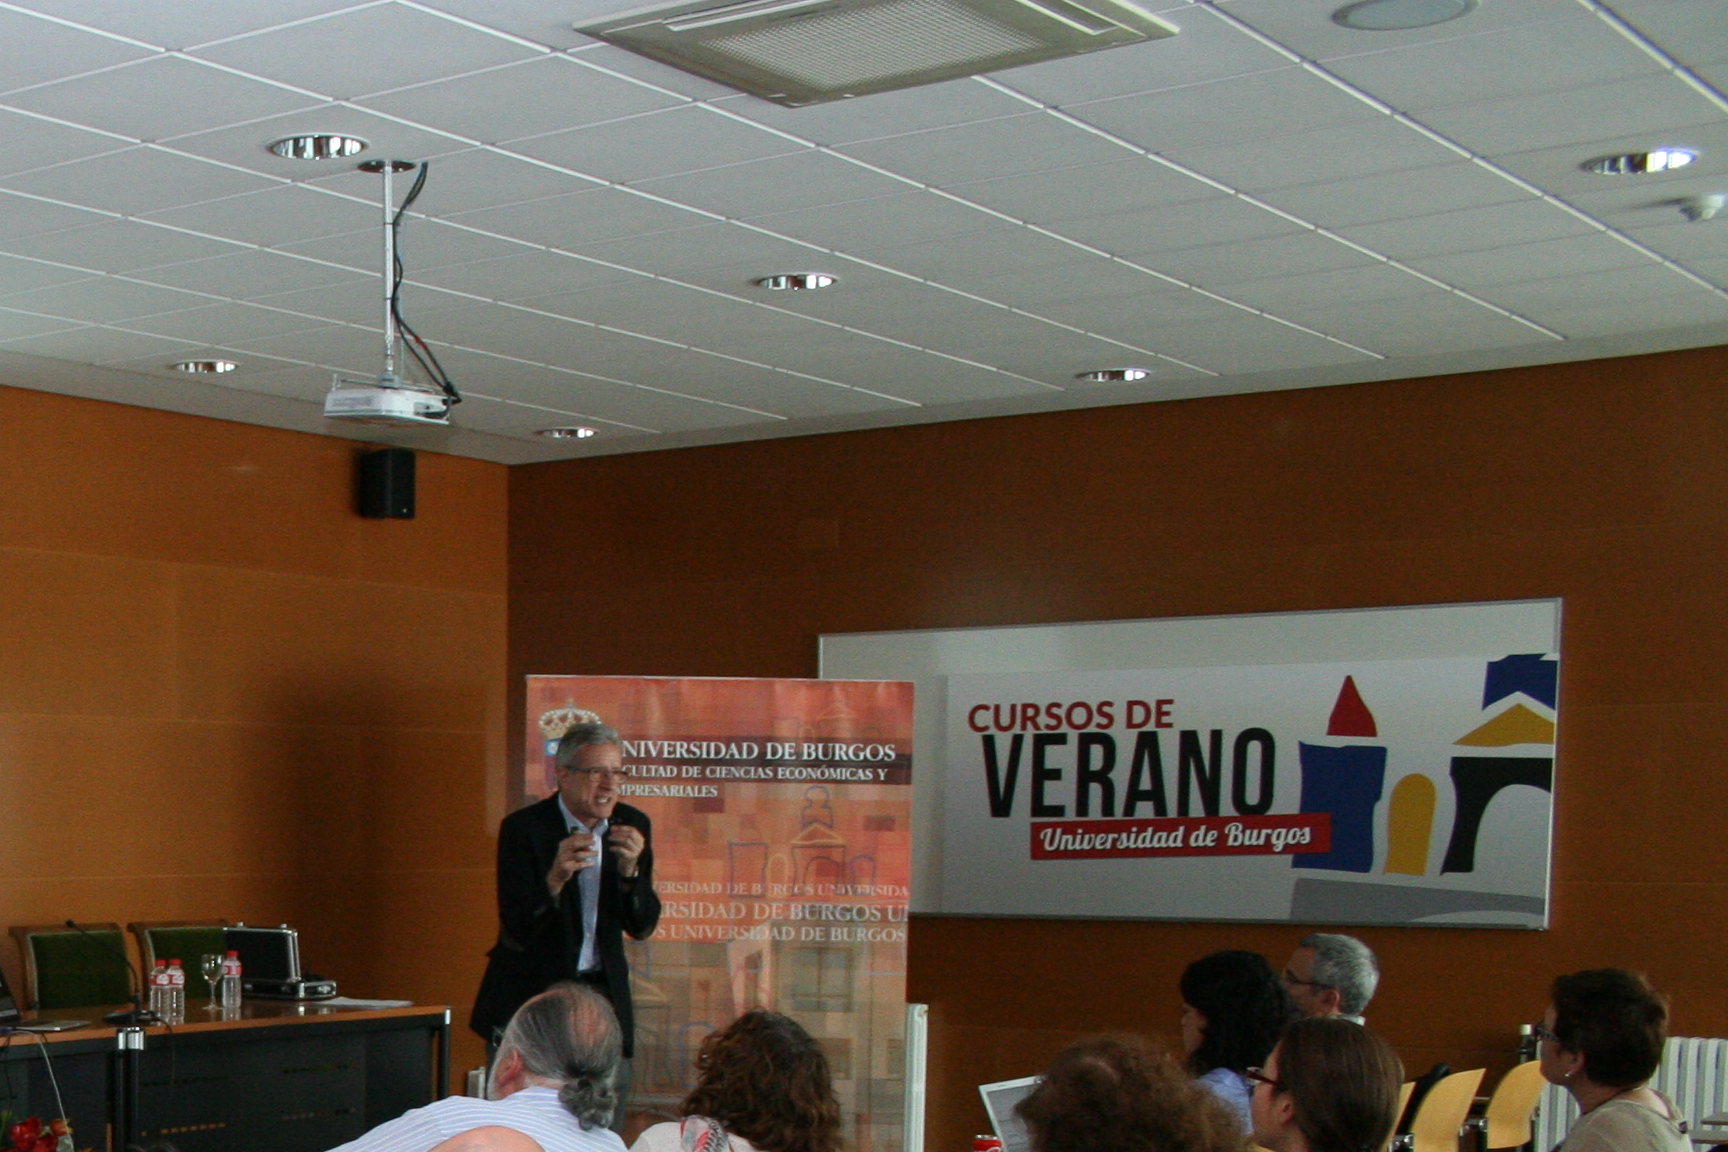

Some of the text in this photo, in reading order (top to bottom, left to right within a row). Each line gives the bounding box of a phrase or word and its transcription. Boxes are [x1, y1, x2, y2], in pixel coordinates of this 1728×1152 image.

[967, 699, 1174, 732] CURSOS DE
[622, 740, 896, 761] NIVERSIDAD DE BURGOS
[621, 764, 888, 781] CULTAD DE CIENCIAS ECONÓMICAS Y
[981, 727, 1276, 818] VERANO
[617, 783, 718, 797] MPRESARIALES
[1040, 822, 1312, 852] Universidad de Burgos
[753, 902, 784, 920] DE
[789, 903, 882, 921] BURGOS
[670, 924, 795, 940] UNIVERSIDAD
[800, 926, 825, 941] DE
[830, 926, 906, 942] BURGOS
